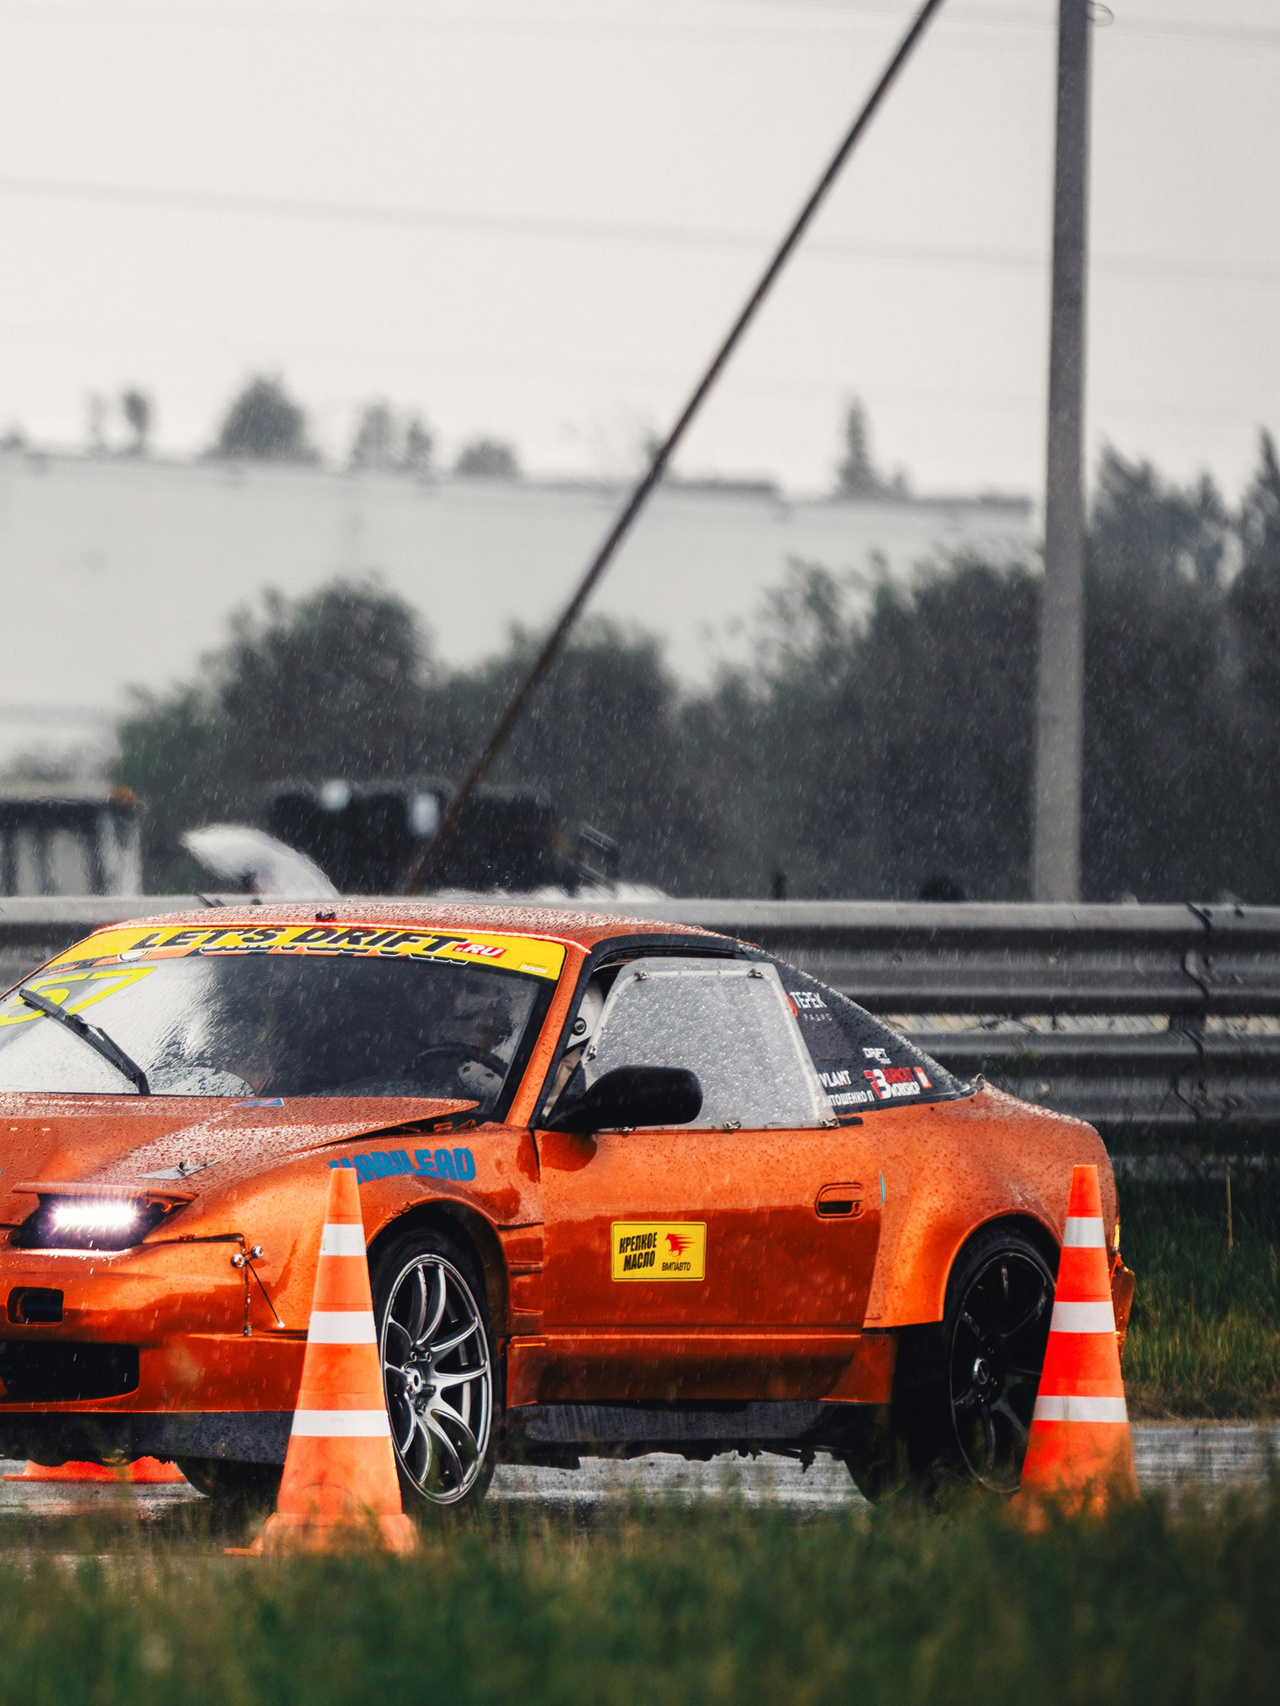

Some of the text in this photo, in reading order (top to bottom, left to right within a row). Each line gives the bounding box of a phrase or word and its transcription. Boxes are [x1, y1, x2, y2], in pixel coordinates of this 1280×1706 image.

[128, 927, 286, 951] LET'S
[619, 1232, 658, 1254] КРЕПКОЕ
[623, 1250, 656, 1272] МАСЛО
[662, 1261, 691, 1271] ВМПАВТО
